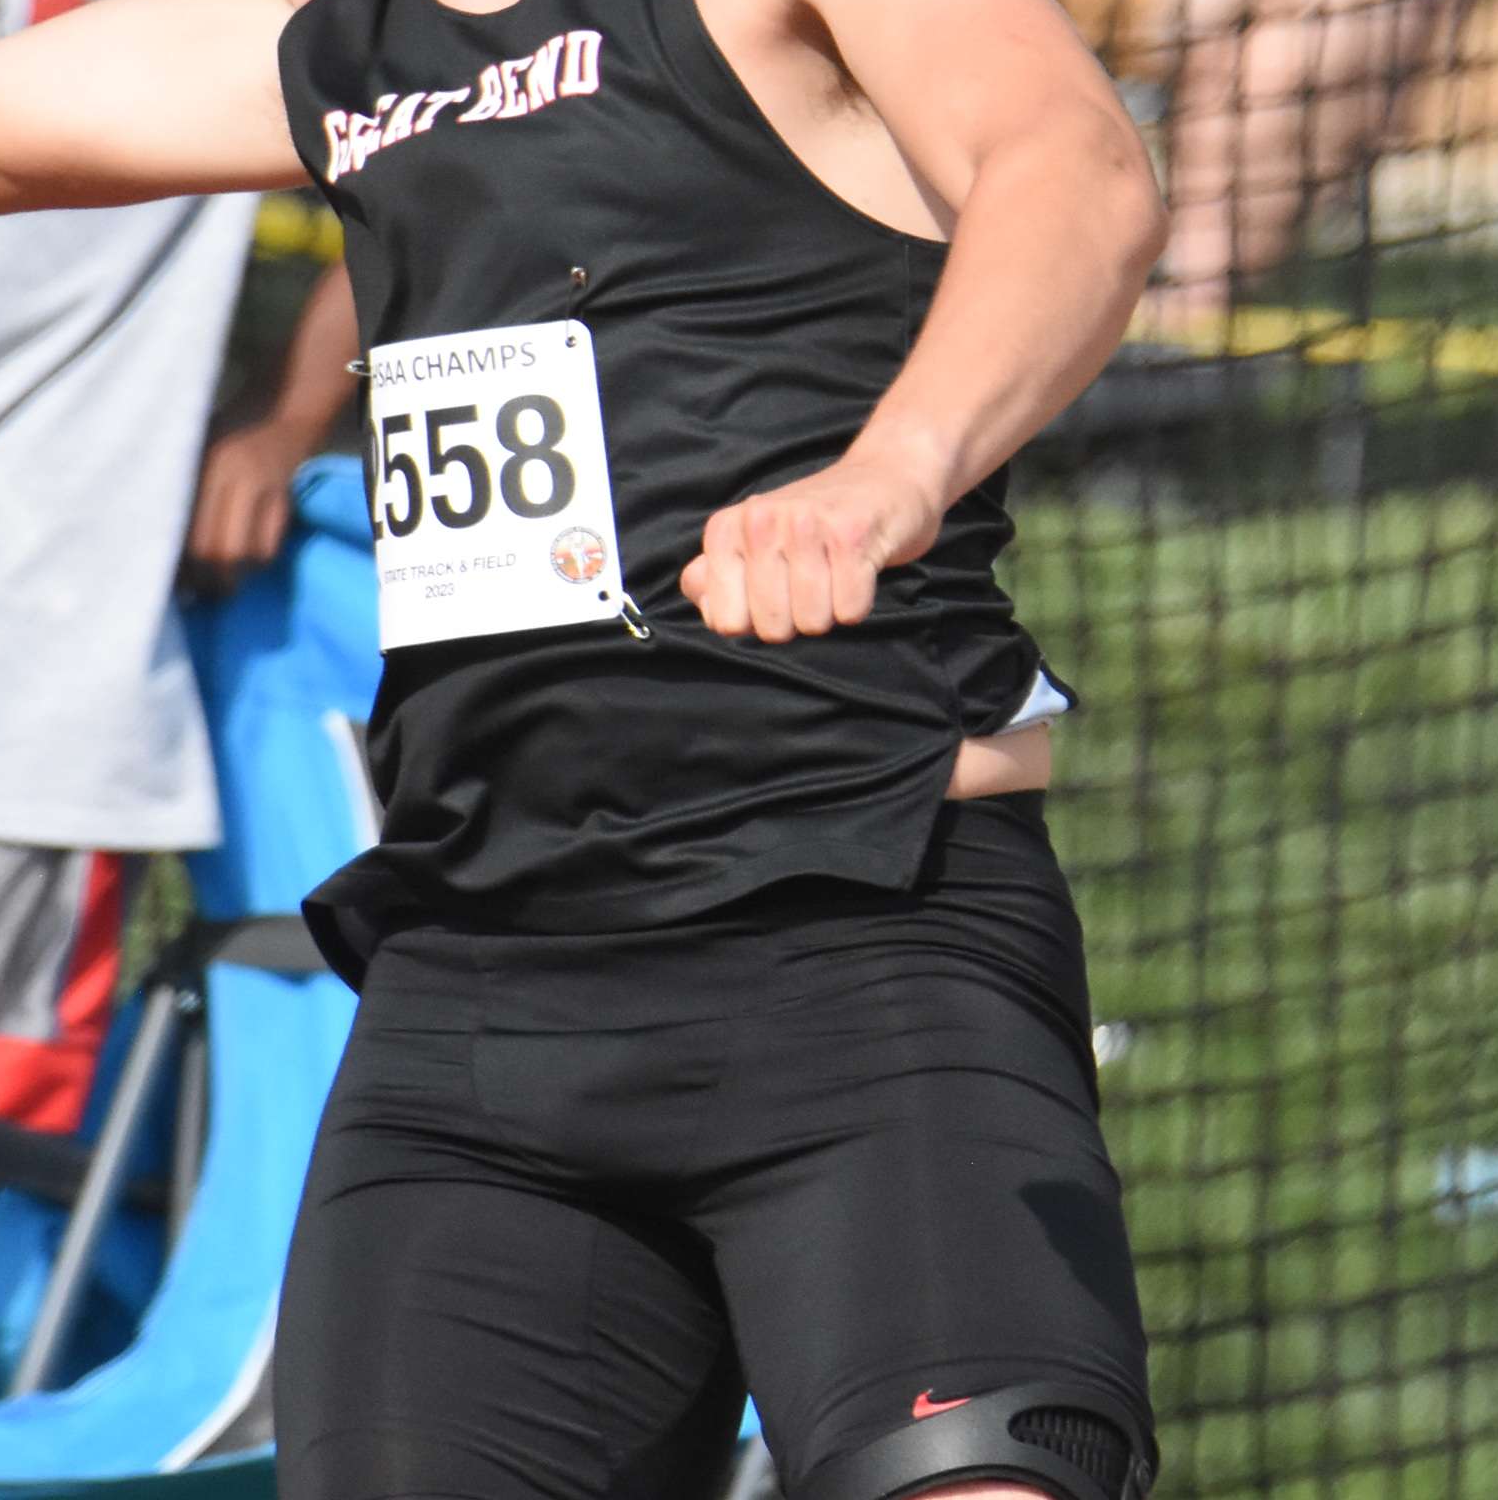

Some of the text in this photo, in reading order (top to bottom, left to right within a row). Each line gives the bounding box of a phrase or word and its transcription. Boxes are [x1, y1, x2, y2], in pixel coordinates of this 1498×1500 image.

[456, 29, 603, 124] BEND
[412, 341, 537, 381] CHAMPS
[411, 560, 454, 580] TRACK
[459, 560, 468, 573] &
[473, 553, 517, 571] FIELD
